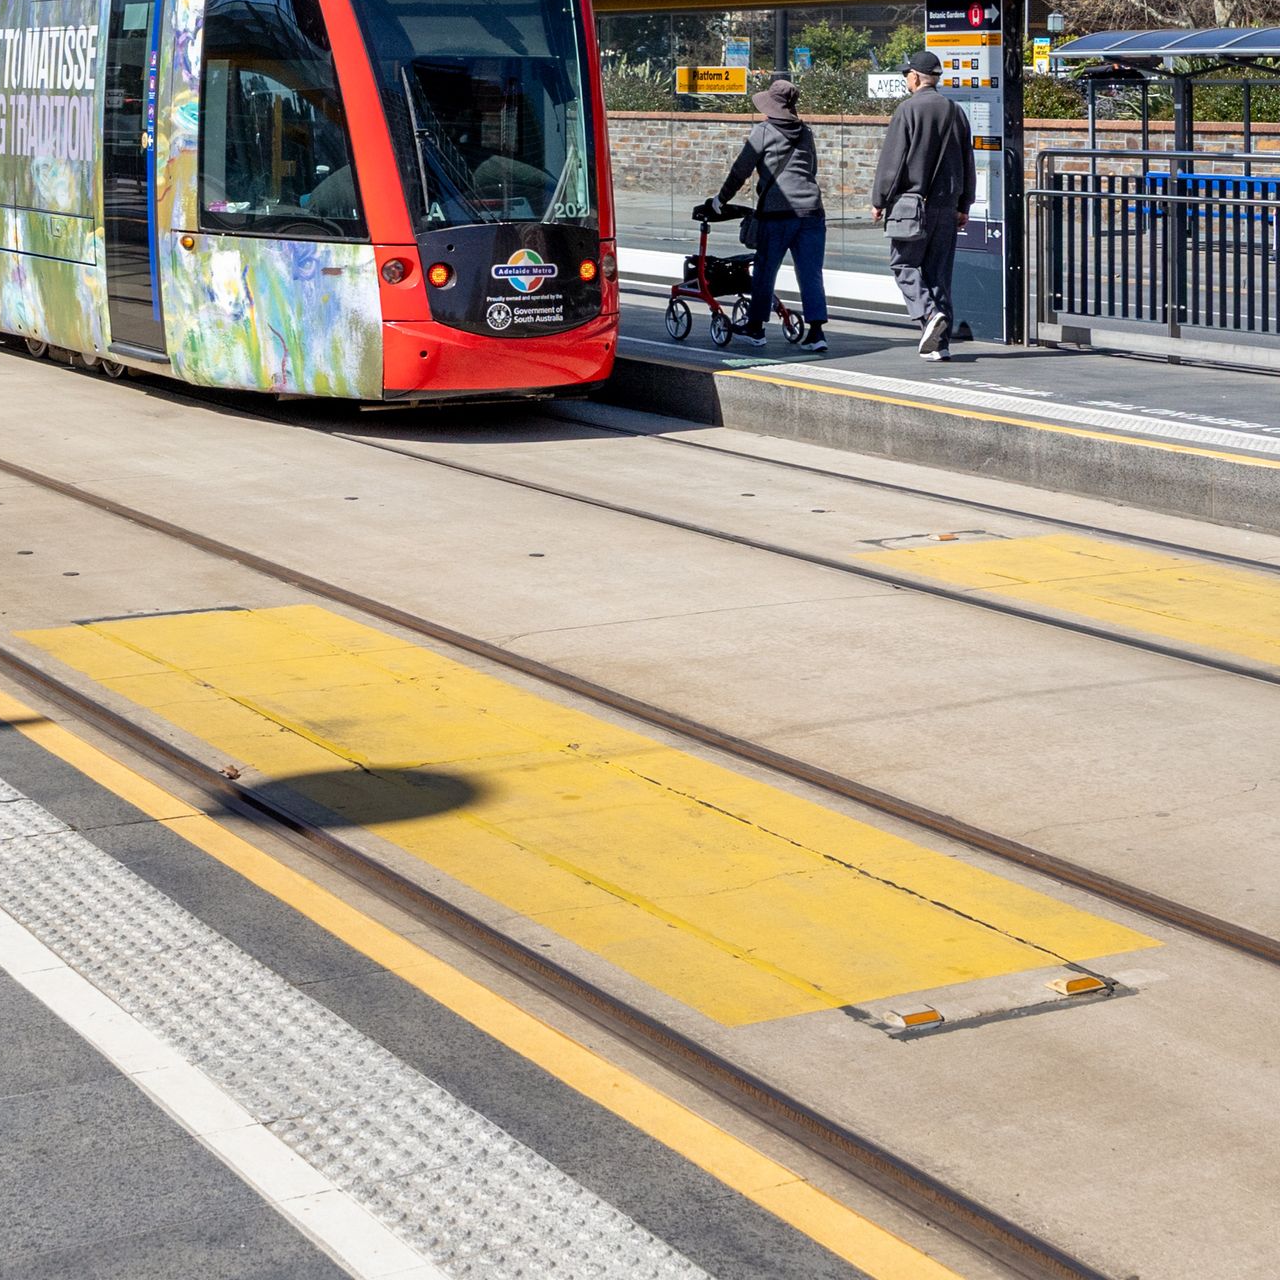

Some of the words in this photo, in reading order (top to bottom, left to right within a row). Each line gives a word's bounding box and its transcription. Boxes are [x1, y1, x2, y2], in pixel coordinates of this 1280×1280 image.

[946, 11, 965, 19] Gardens
[4, 28, 23, 89] TO
[23, 25, 98, 90] MATISSE
[693, 71, 722, 80] Platform
[725, 71, 730, 80] 2
[877, 80, 906, 92] AYERS
[10, 94, 95, 162] TRADITION
[427, 202, 446, 221] A
[554, 202, 588, 218] 202
[514, 307, 554, 315] Government
[534, 314, 563, 322] Australia
[1141, 408, 1268, 428] BEHIND
